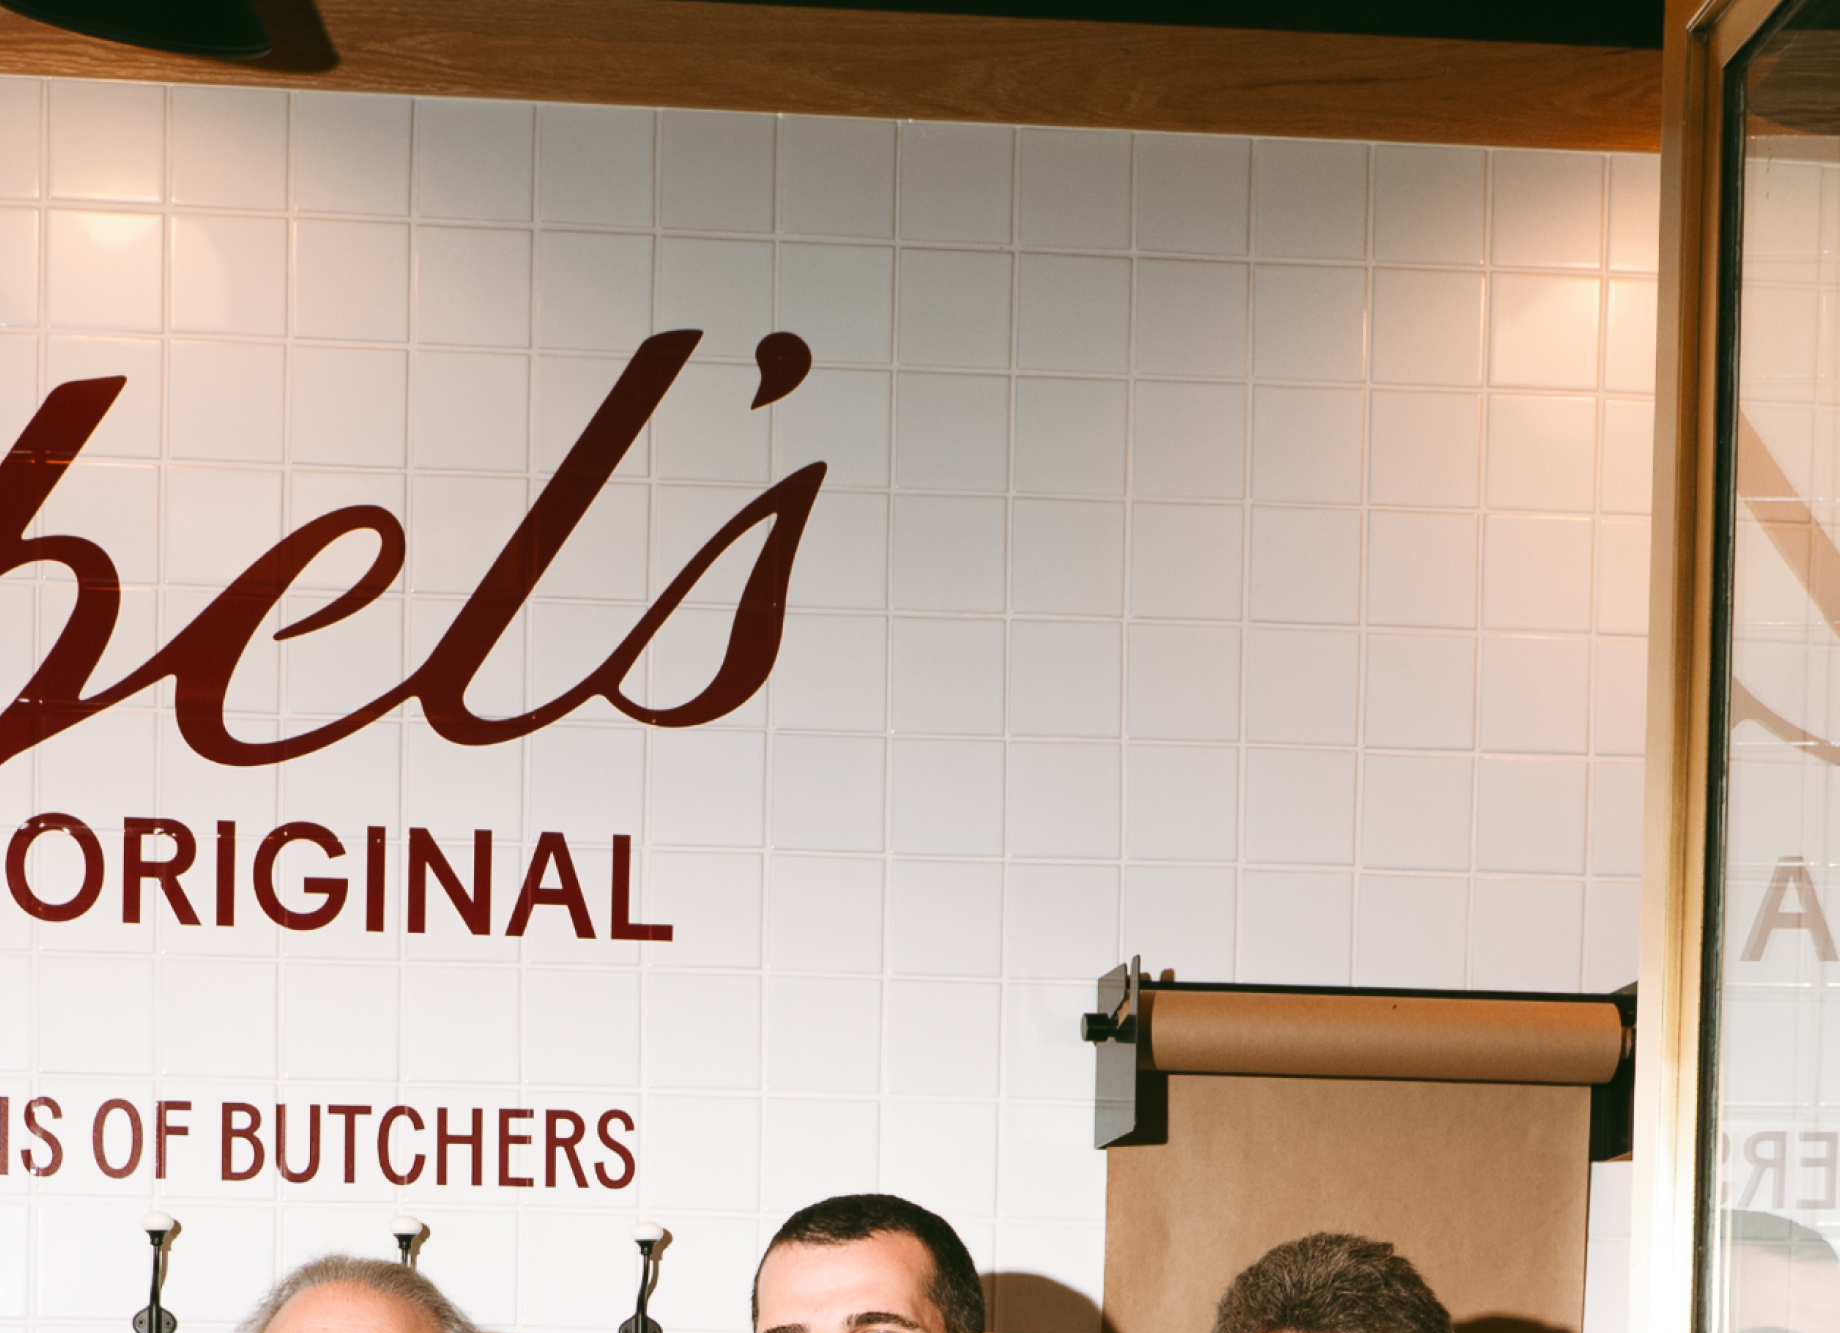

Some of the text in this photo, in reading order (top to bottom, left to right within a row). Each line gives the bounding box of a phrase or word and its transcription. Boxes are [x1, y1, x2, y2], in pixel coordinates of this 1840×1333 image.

[3, 812, 675, 943] ORIGINAL
[91, 1098, 193, 1180] OF
[220, 1102, 637, 1189] BUTCHERS
